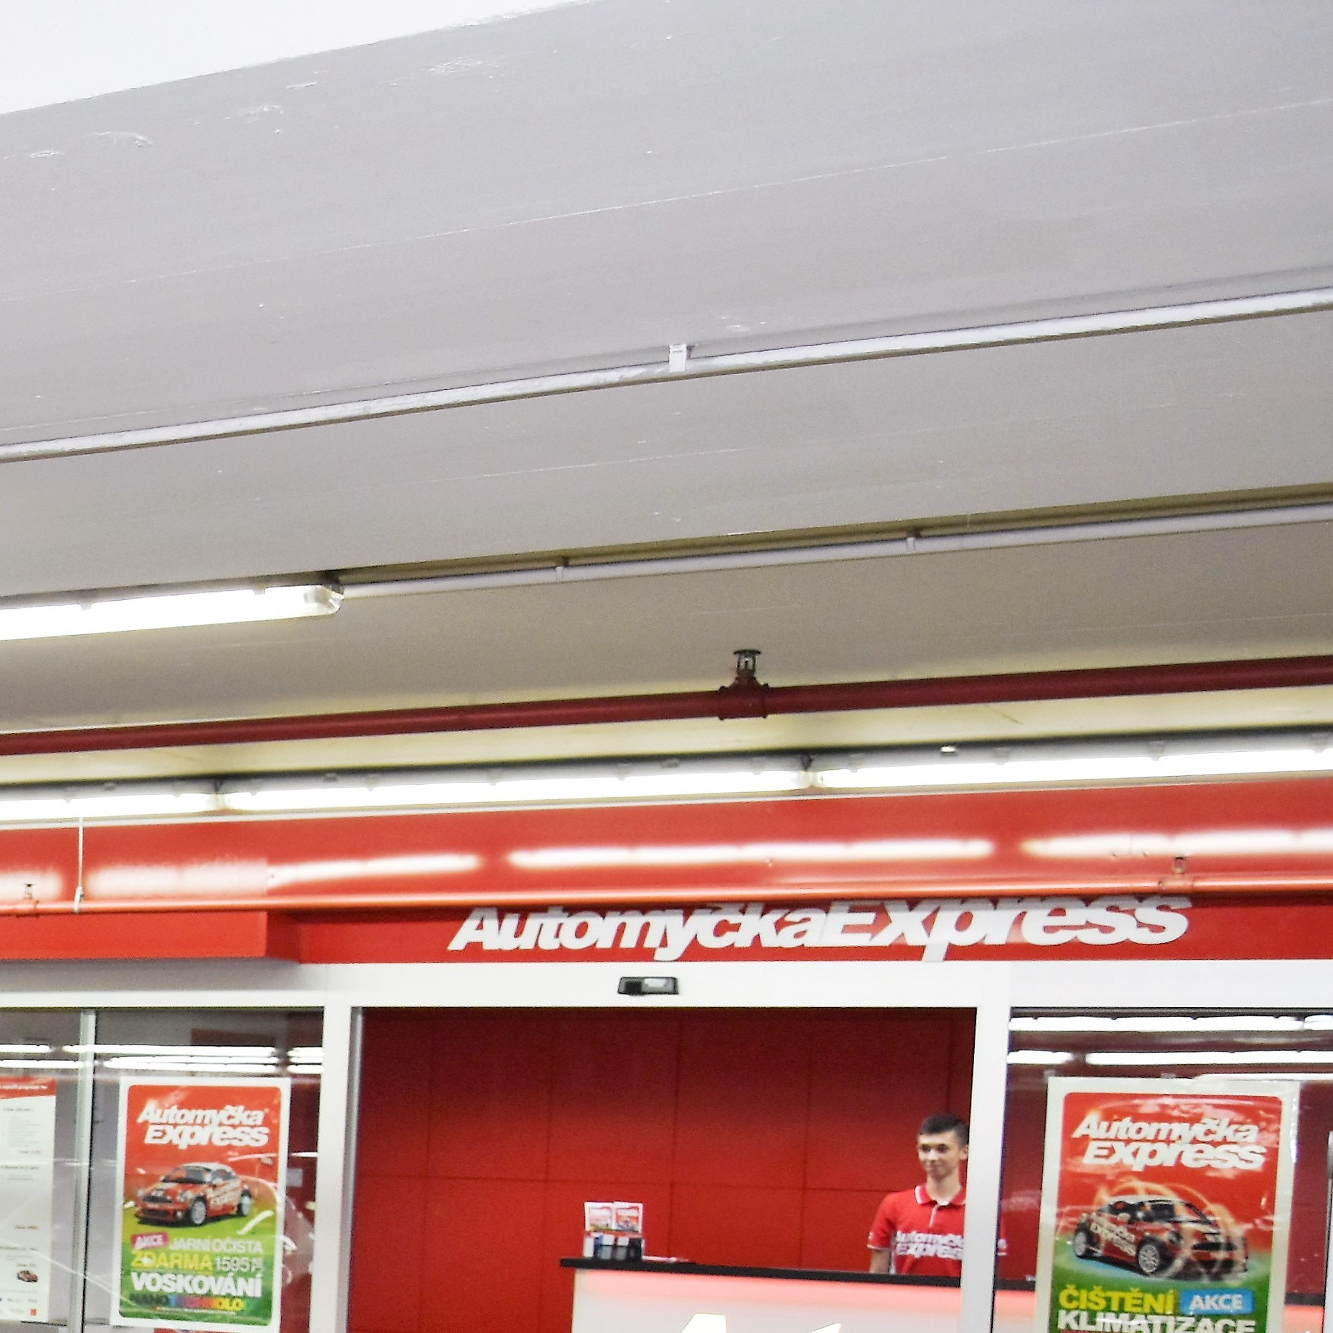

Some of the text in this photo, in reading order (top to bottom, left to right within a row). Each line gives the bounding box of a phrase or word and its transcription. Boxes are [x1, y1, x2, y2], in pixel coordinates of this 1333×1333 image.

[137, 1100, 265, 1127] Automyčka
[144, 1124, 270, 1150] Express
[1072, 1112, 1259, 1143] Automyčka
[1084, 1141, 1267, 1171] Express
[131, 1250, 213, 1271] ZDARMA
[130, 1271, 263, 1298] VOSKOVÁNÍ
[1059, 1284, 1243, 1314] ČIŠTĚNÍ AKCE
